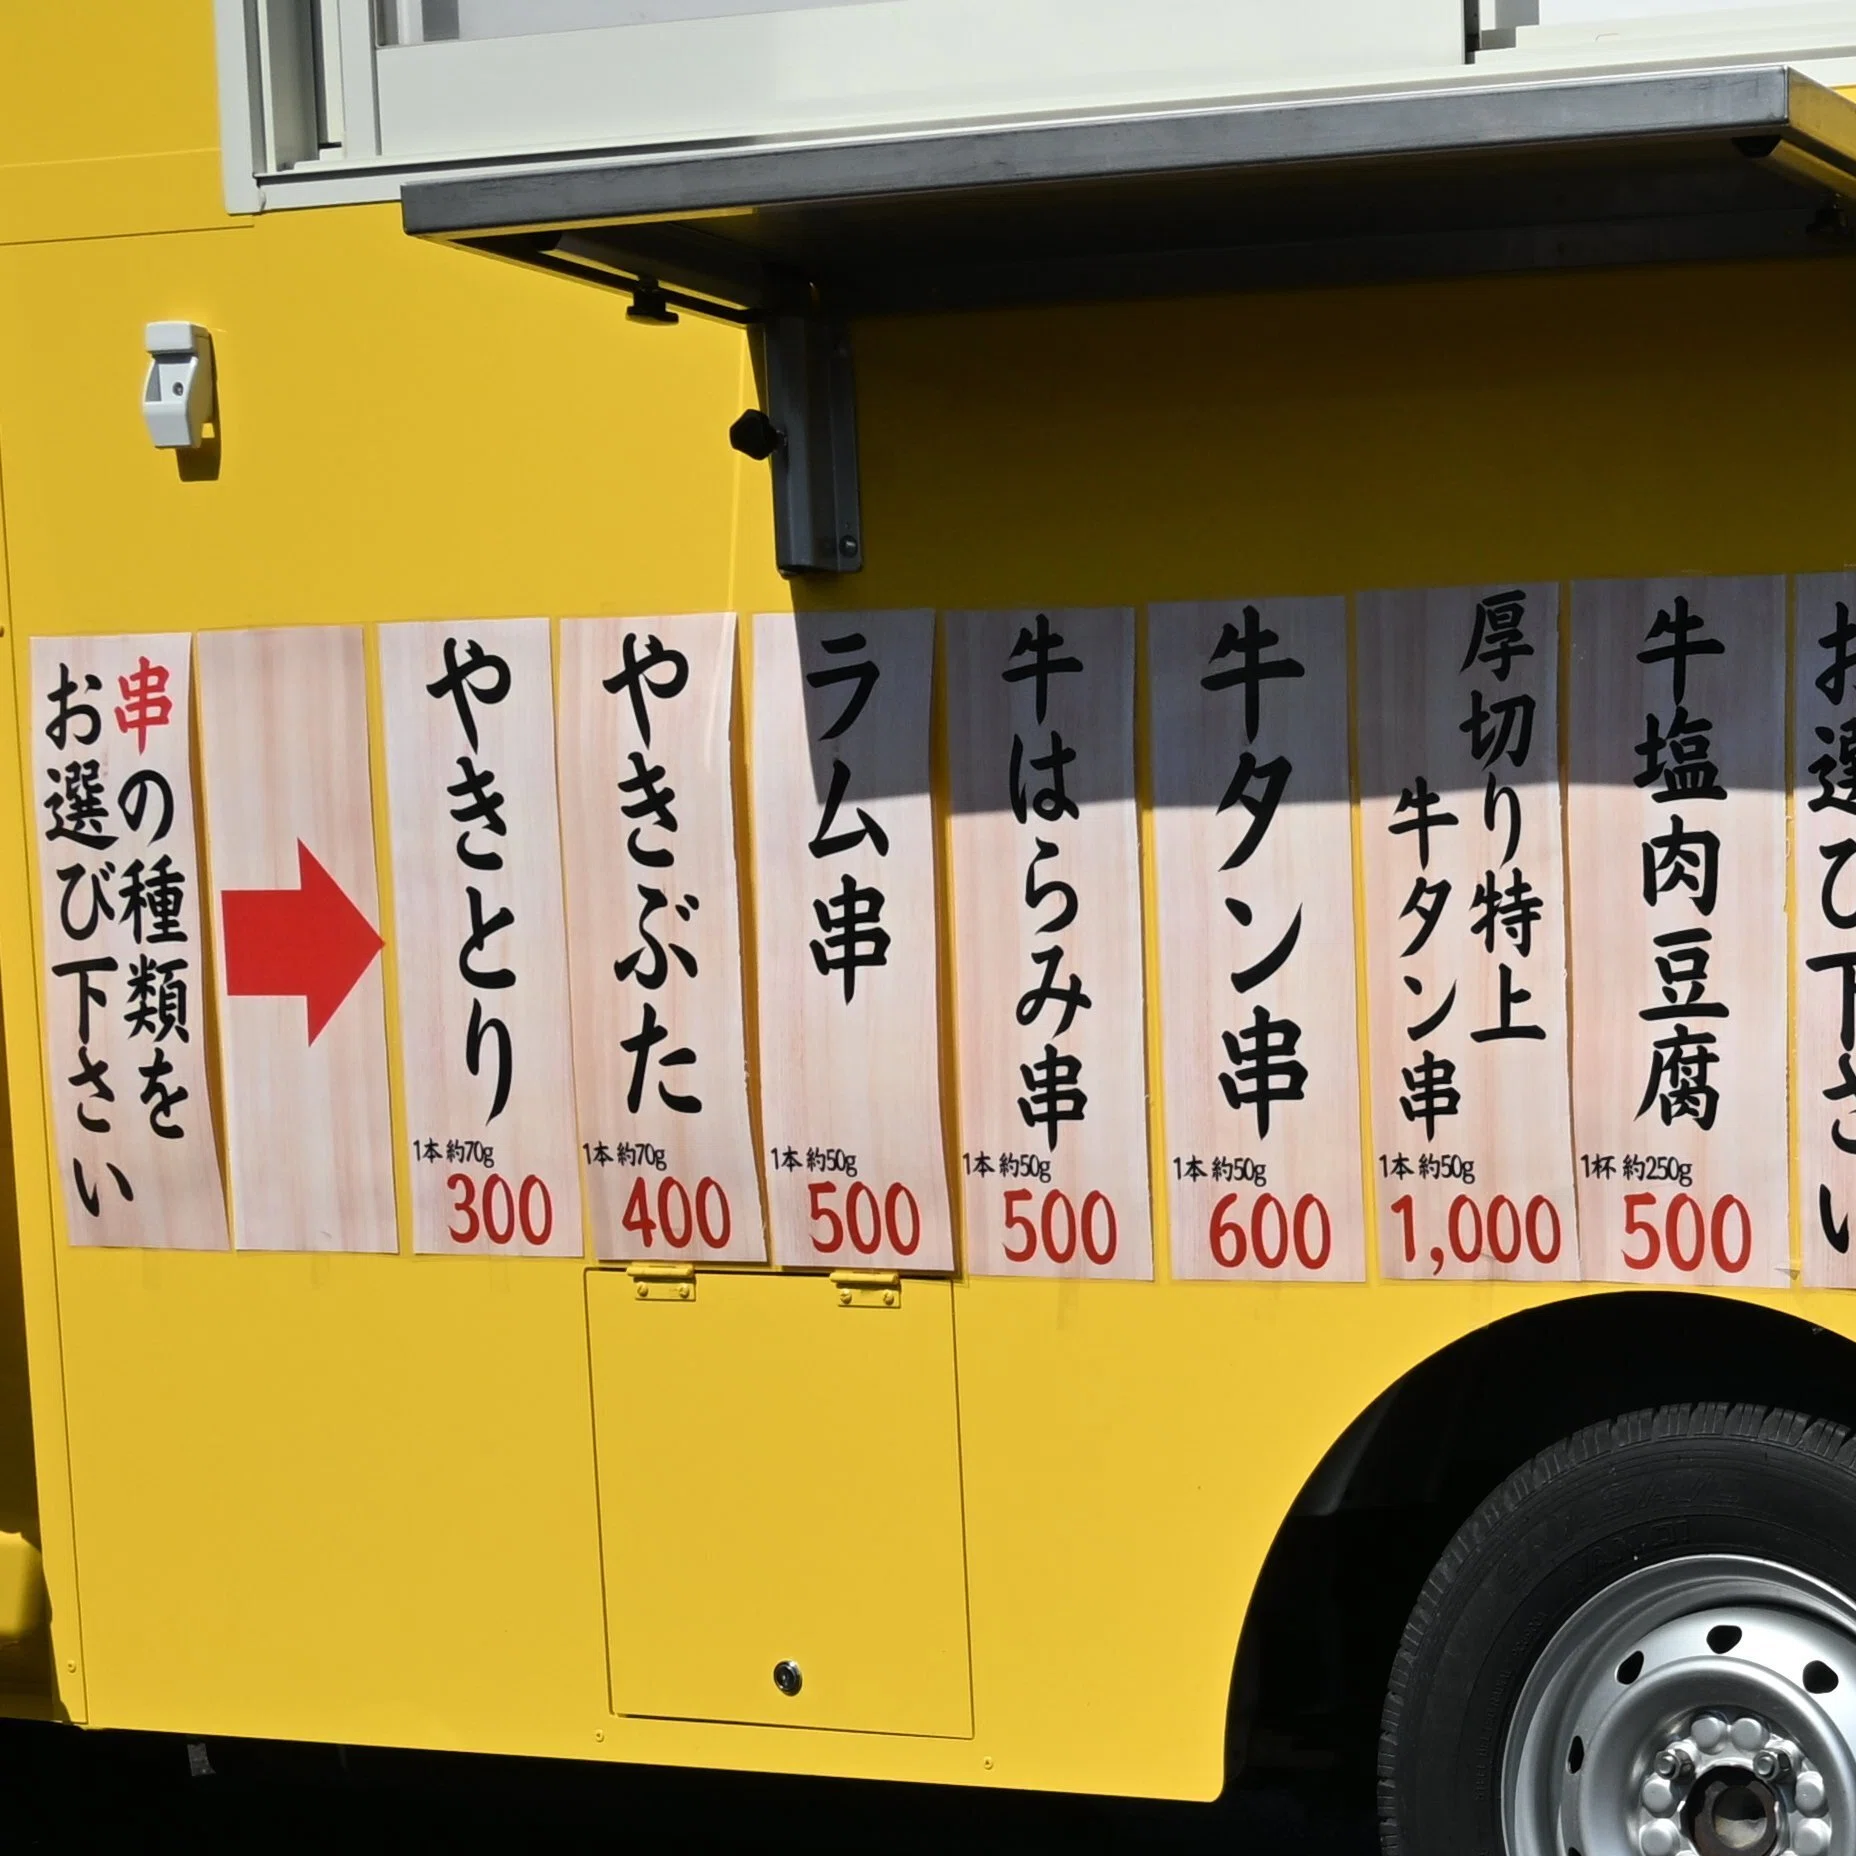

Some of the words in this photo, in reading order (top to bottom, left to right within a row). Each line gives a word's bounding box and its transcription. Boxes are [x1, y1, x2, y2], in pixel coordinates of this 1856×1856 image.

[804, 630, 894, 1006] ラム串
[1456, 588, 1550, 1044] 厚切り特上
[112, 655, 190, 1140] 串の種類を
[425, 637, 517, 1127] やきとり
[601, 632, 703, 1115] やきぶた
[998, 612, 1094, 1153] 牛はらみ串
[1198, 604, 1309, 1141] 牛タン串
[1632, 594, 1732, 1132] 牛塩肉豆腐
[43, 662, 137, 1221] お選び下さい
[1384, 774, 1466, 1143] 牛タン串
[412, 1137, 444, 1164] 1本
[445, 1138, 495, 1169] 約70g
[582, 1140, 615, 1168] 1本
[616, 1141, 668, 1172] 約70g
[770, 1145, 804, 1173] 1本
[805, 1146, 858, 1178] 約50g
[962, 1150, 996, 1179] 1本
[998, 1151, 1052, 1184] 約50g
[1172, 1154, 1209, 1183] 1本
[1211, 1155, 1267, 1188] 約50g
[1378, 1151, 1416, 1181] 1本
[1418, 1152, 1476, 1185] 約50g
[1622, 1153, 1694, 1188] 約250g
[446, 1172, 553, 1246] 300
[621, 1175, 731, 1250] 400
[807, 1180, 921, 1257] 500
[1003, 1187, 1118, 1266] 500
[1209, 1192, 1332, 1270] 600
[1390, 1193, 1562, 1276] 1,000
[1621, 1191, 1752, 1274] 500
